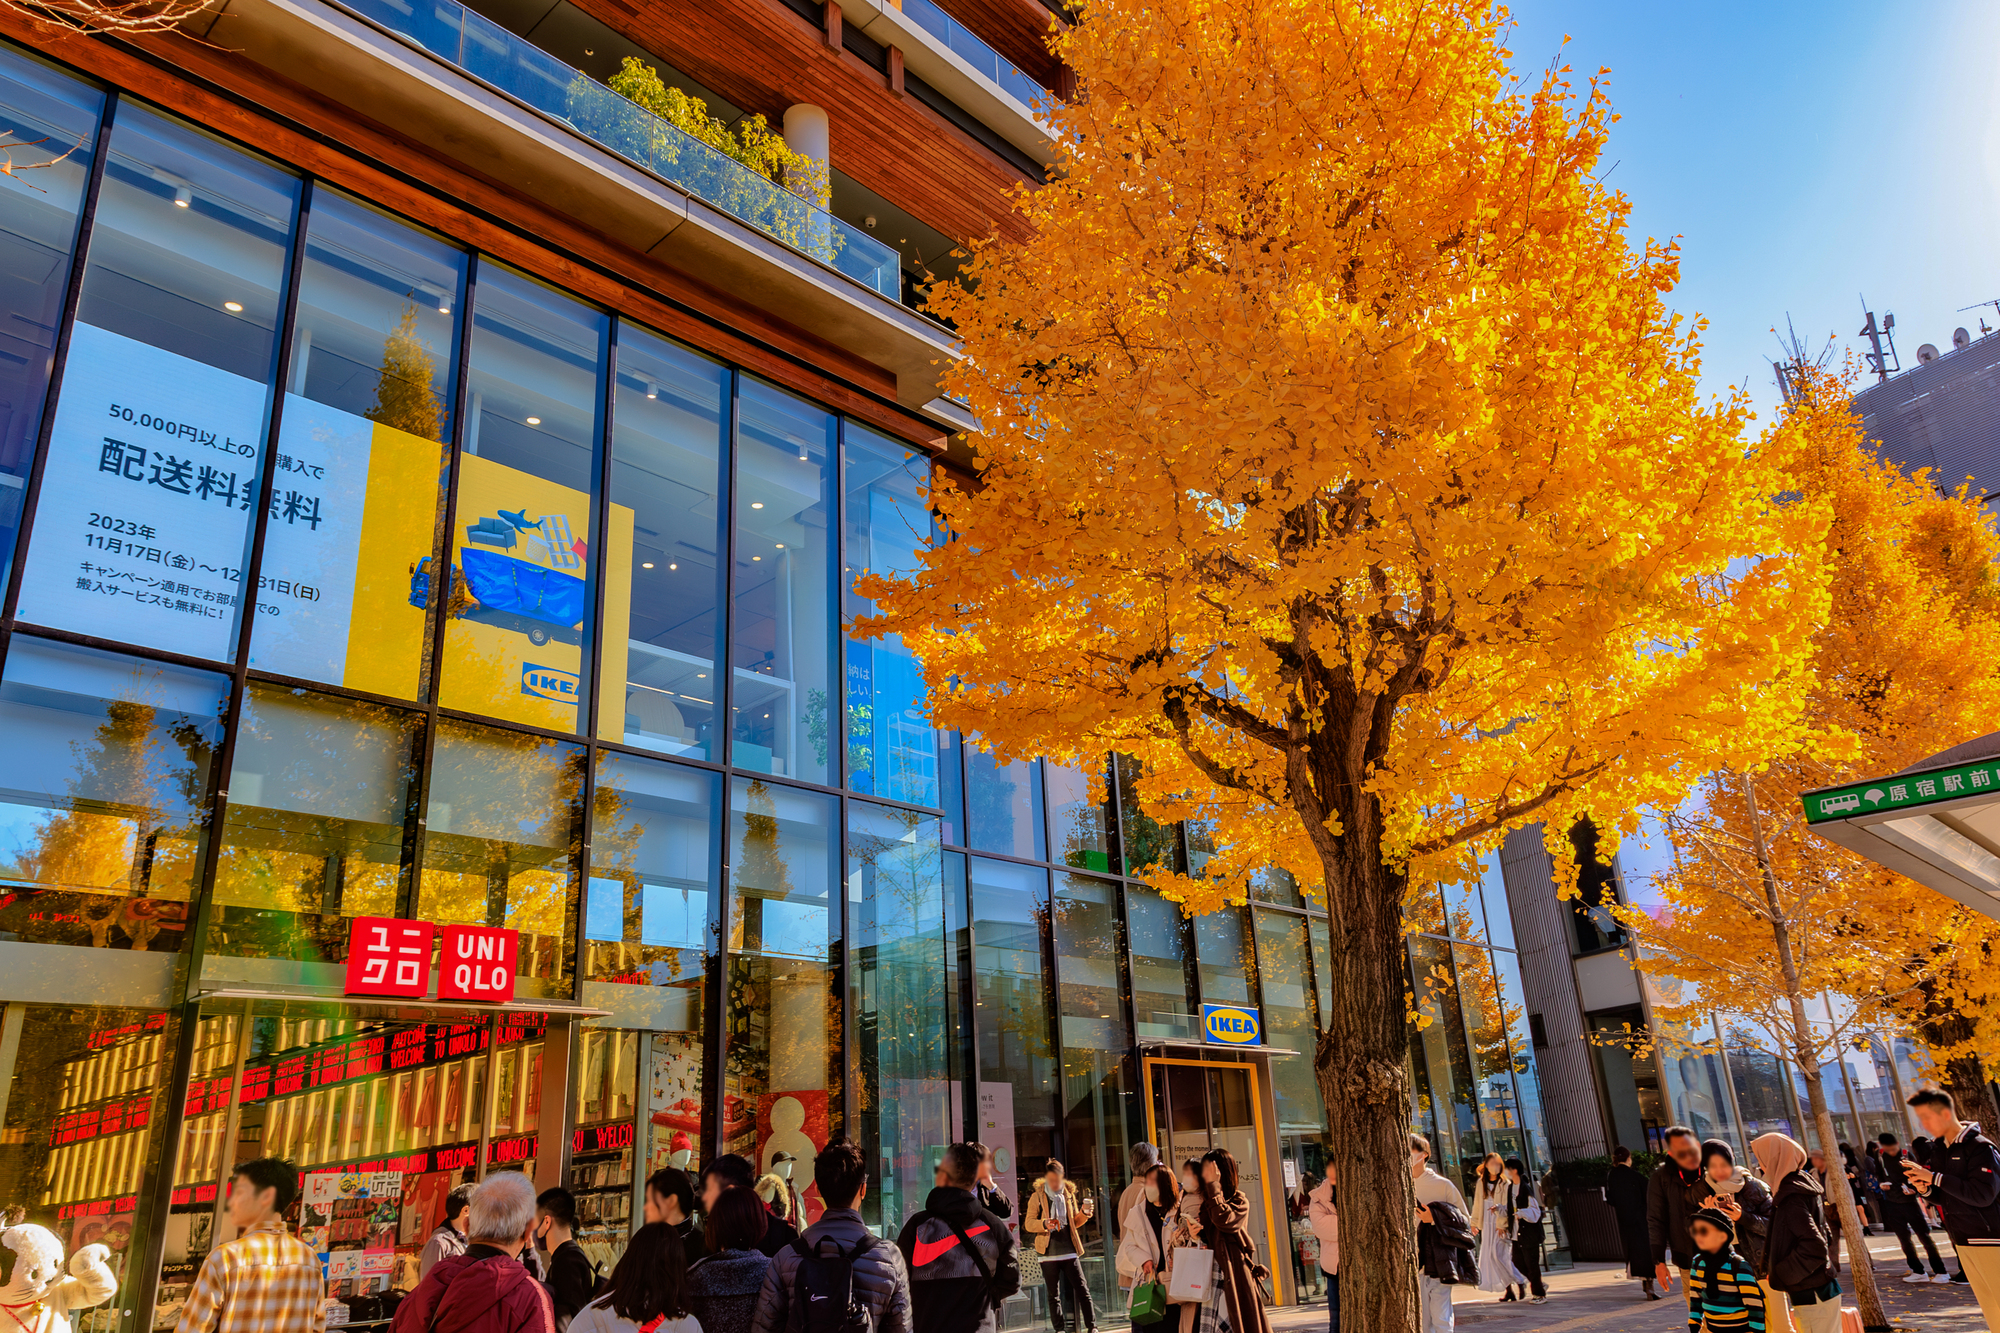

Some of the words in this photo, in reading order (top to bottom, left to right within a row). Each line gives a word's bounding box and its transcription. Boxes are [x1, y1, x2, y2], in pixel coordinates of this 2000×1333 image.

[108, 403, 325, 480] 50,000円以上の購入で
[87, 512, 156, 540] 2023年
[1889, 768, 2000, 803] 原宿駅前
[367, 927, 421, 954] ユニ
[457, 934, 505, 961] UNI
[361, 958, 420, 986] クロ
[454, 964, 507, 993] QLO
[1210, 1016, 1255, 1034] IKEA
[390, 1044, 427, 1069] WELCOME
[434, 1041, 446, 1059] TO
[448, 1033, 477, 1056] UNIQLO
[436, 1145, 477, 1171] WELCOME
[496, 1138, 529, 1162] UNIQLO
[1174, 1145, 1186, 1154] Enjoy
[371, 1181, 386, 1193] UT
[386, 1187, 400, 1198] UT
